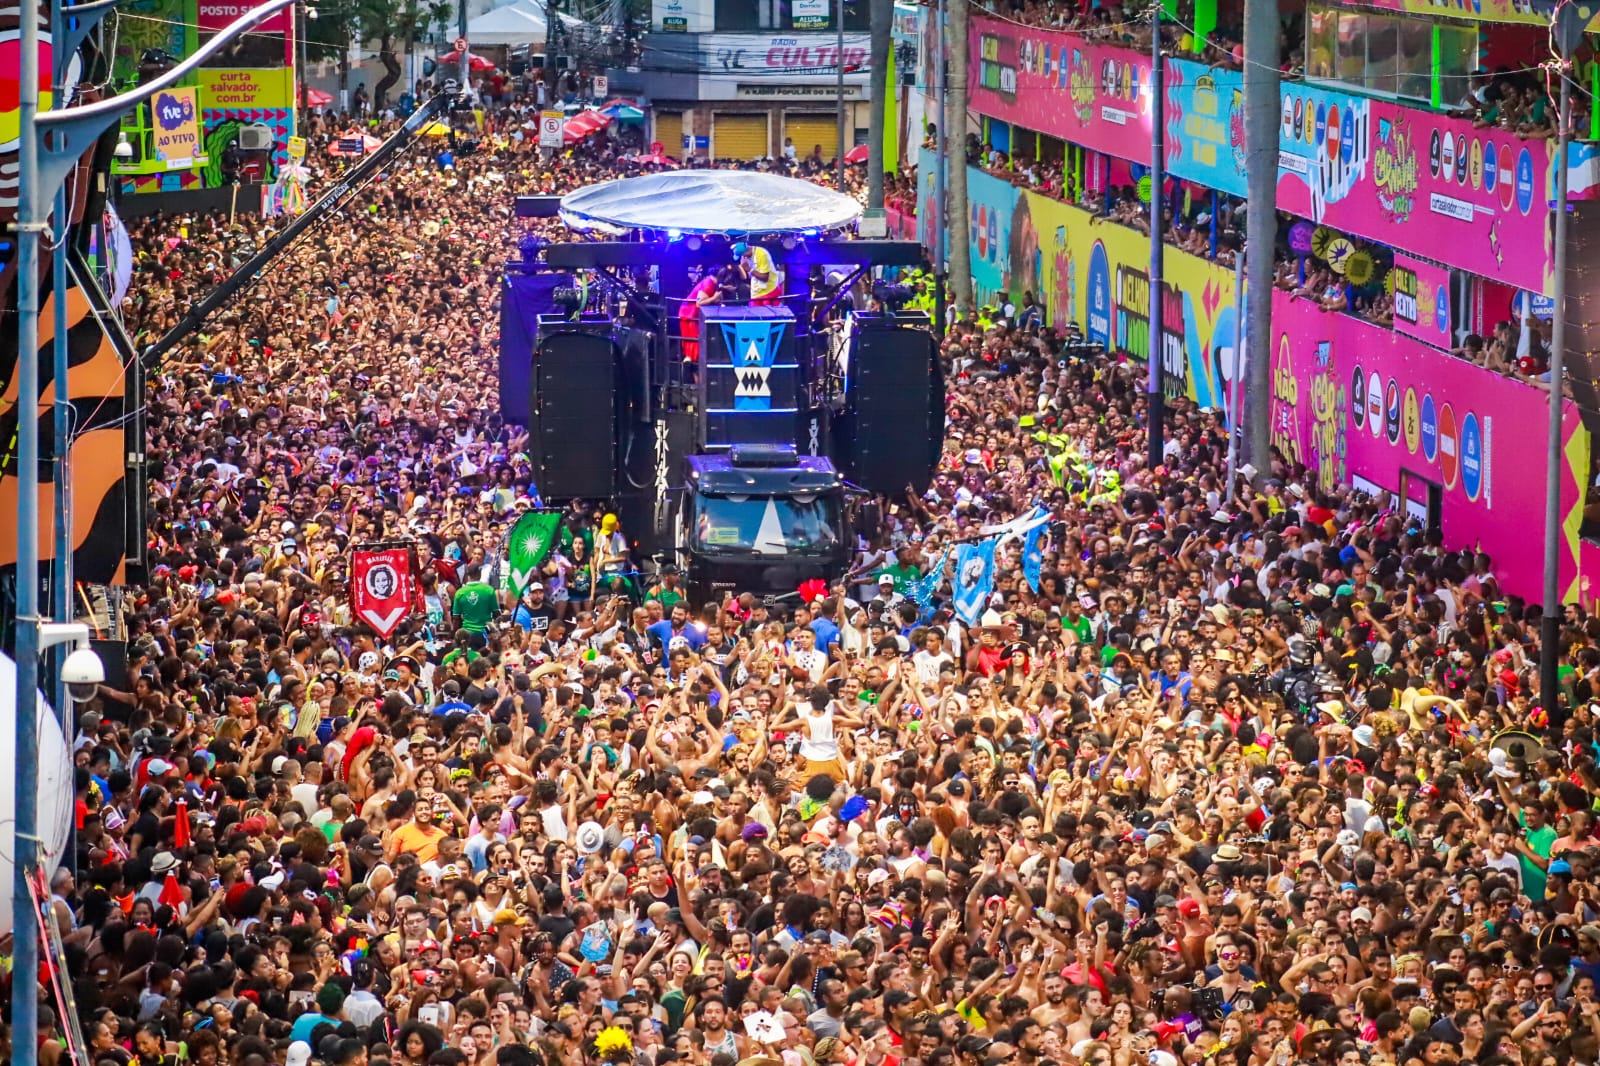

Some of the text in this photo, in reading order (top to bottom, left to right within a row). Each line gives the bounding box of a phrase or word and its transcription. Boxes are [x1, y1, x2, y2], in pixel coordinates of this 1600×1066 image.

[200, 6, 238, 16] POSTO
[765, 47, 872, 67] CULTUR
[220, 72, 251, 81] curta
[216, 93, 256, 103] com.br
[162, 105, 181, 120] tve
[158, 133, 195, 146] AO VIVO
[1274, 367, 1297, 406] NÃO
